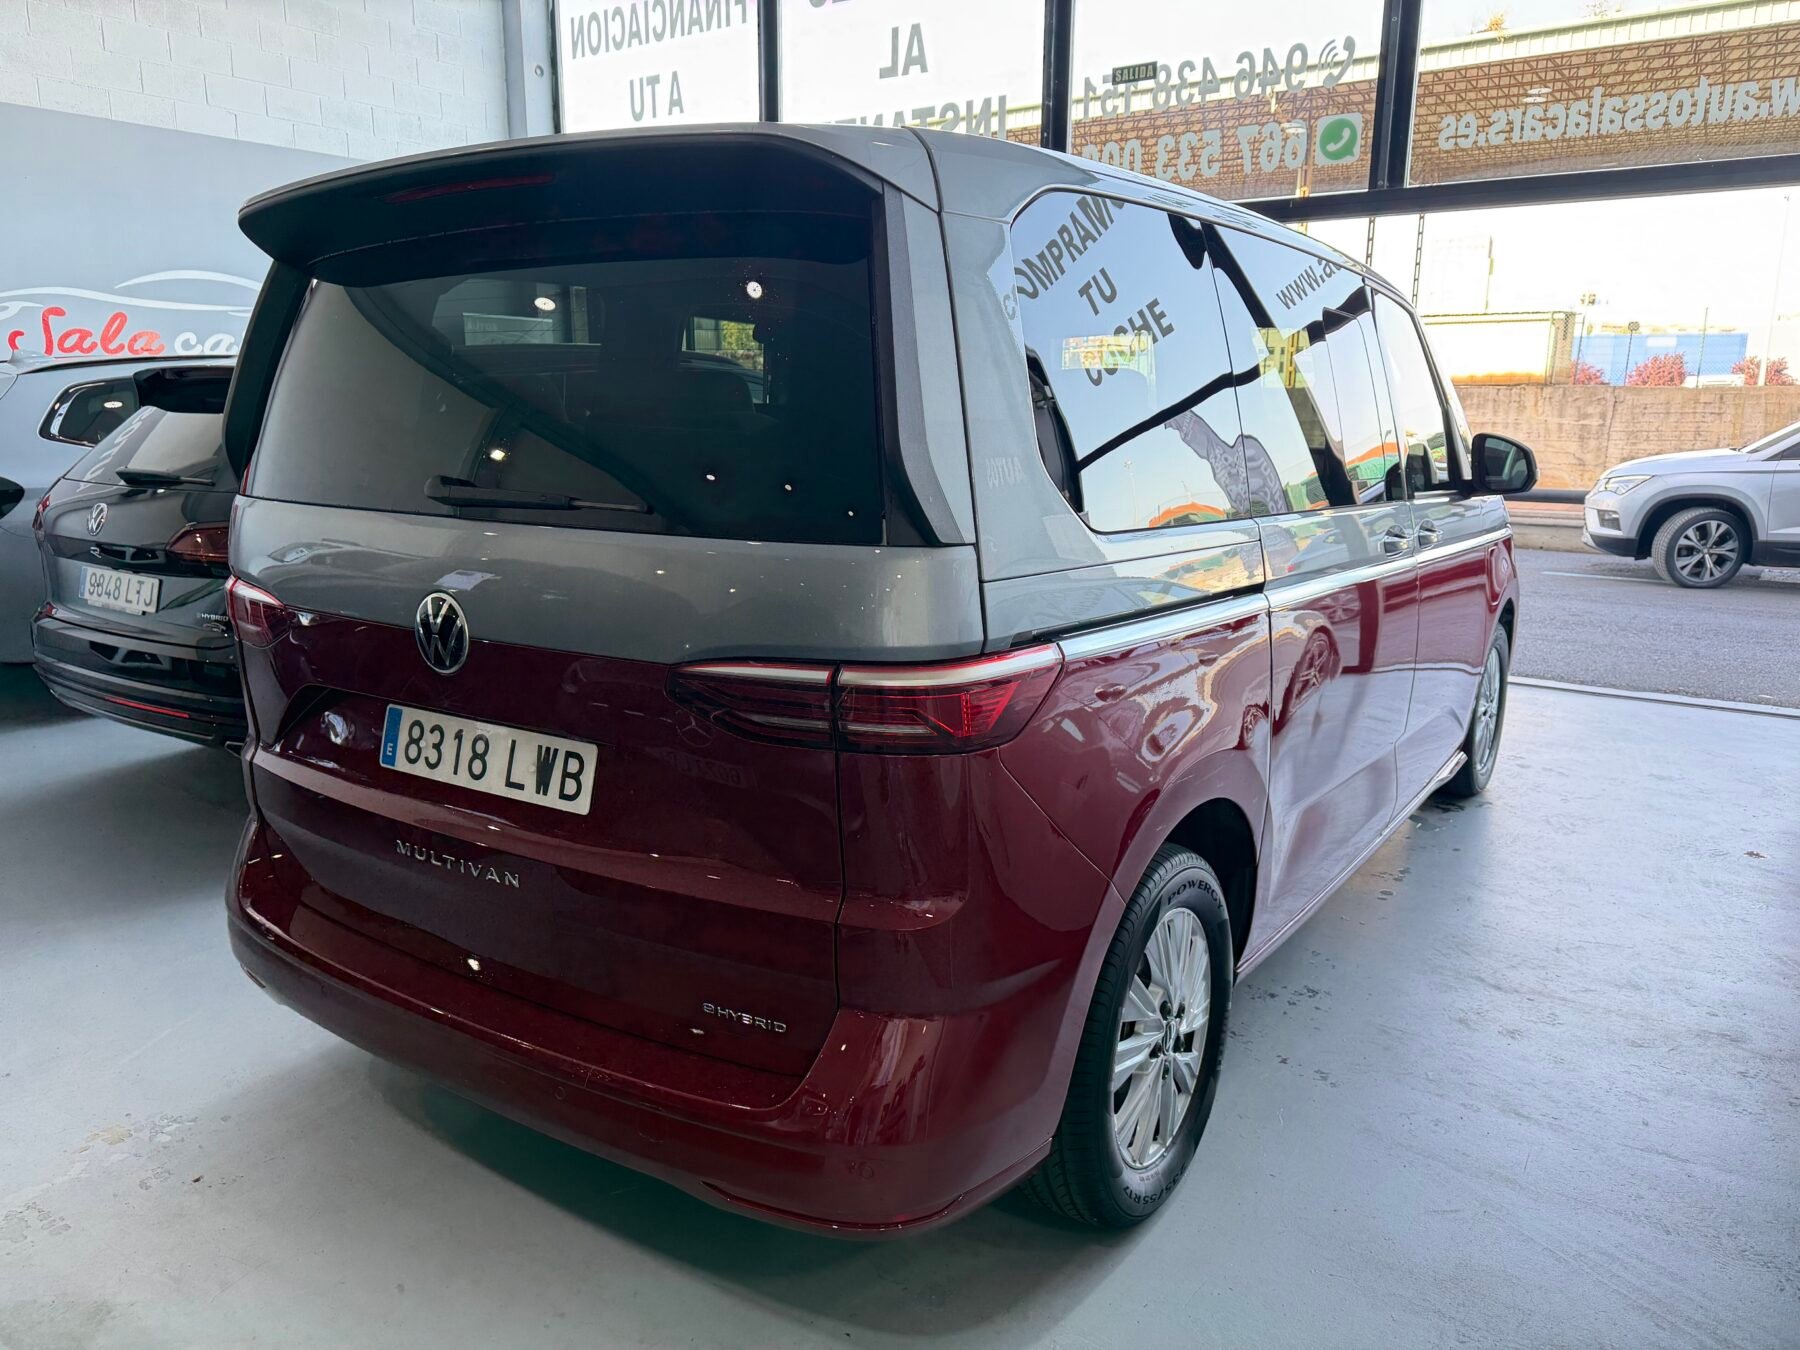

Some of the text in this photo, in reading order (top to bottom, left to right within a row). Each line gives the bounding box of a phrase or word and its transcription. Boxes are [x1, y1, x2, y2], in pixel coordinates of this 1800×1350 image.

[1114, 64, 1155, 82] SALIDA
[1078, 267, 1118, 316] TU
[88, 571, 122, 601] 9848
[124, 577, 154, 608] LTJ
[404, 719, 586, 802] 8318 LWB
[396, 839, 520, 888] MULTIVAN
